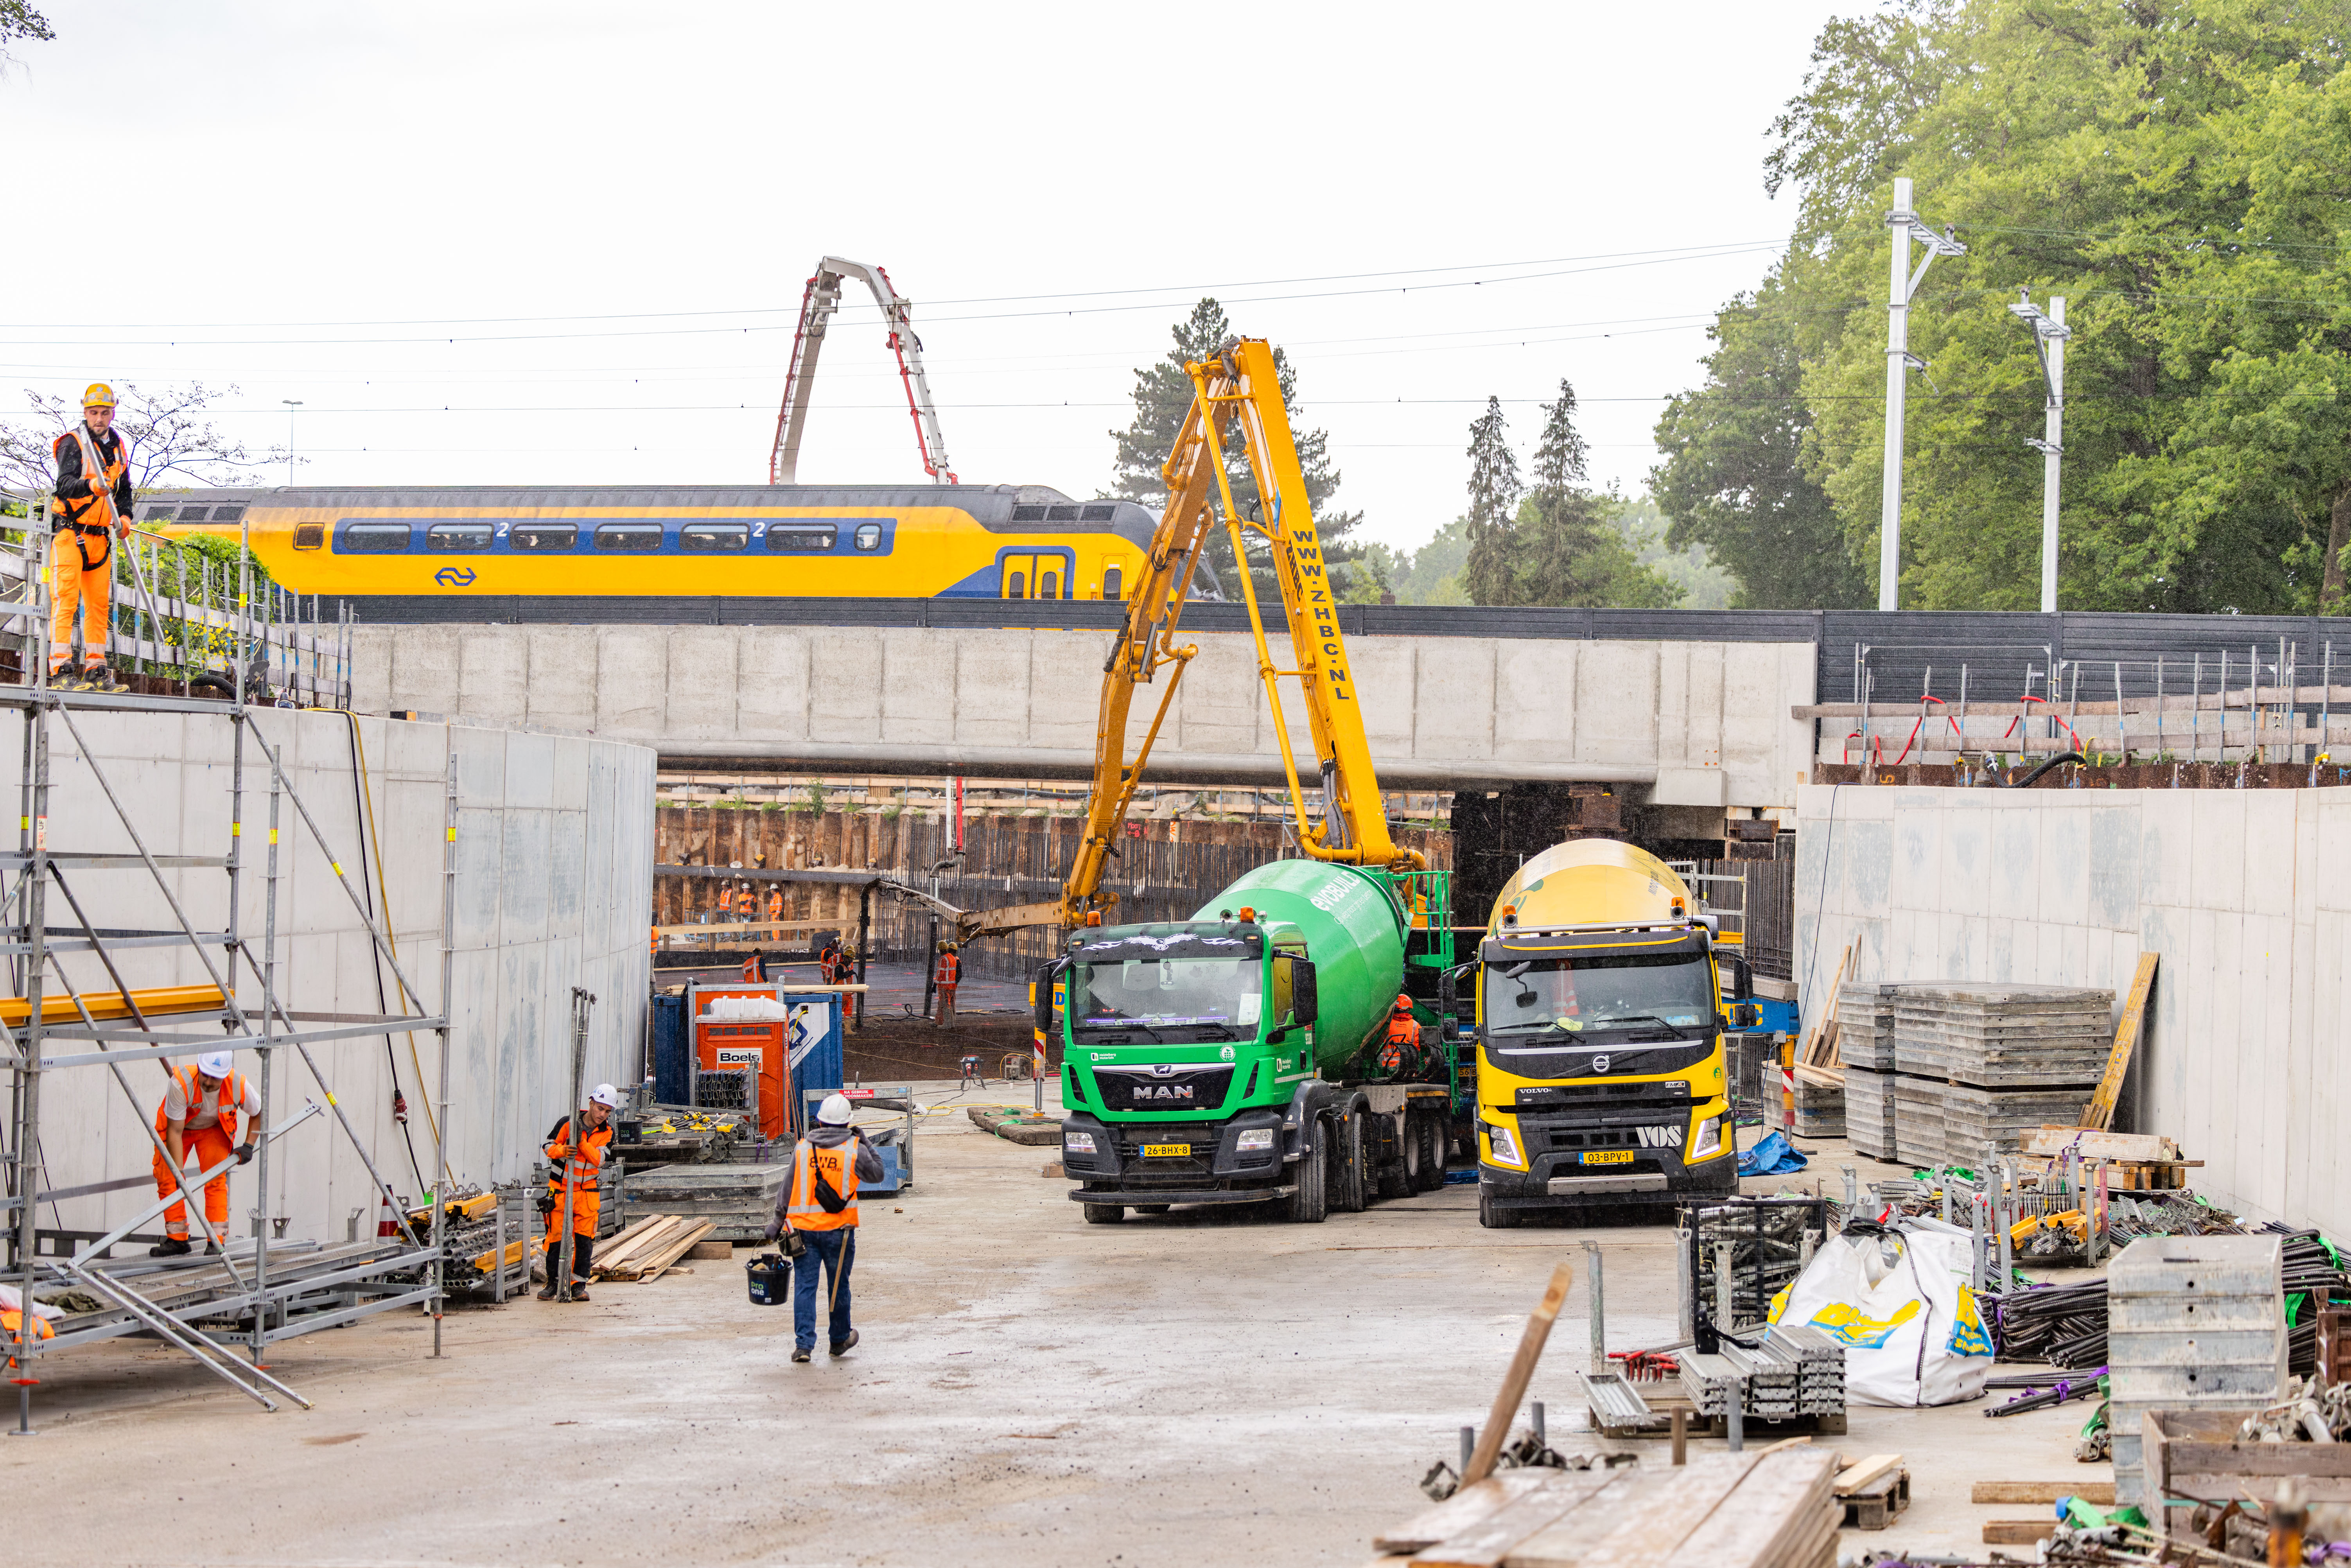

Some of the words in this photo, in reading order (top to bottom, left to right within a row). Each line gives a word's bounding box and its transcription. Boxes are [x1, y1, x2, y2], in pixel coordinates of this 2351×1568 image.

[496, 522, 509, 537] 2
[752, 522, 765, 537] 2
[1134, 1086, 1193, 1099] MAN
[1635, 1125, 1682, 1148] VOS
[1147, 1146, 1187, 1155] 26-BHX-8
[1588, 1152, 1628, 1162] 03-BPV-1
